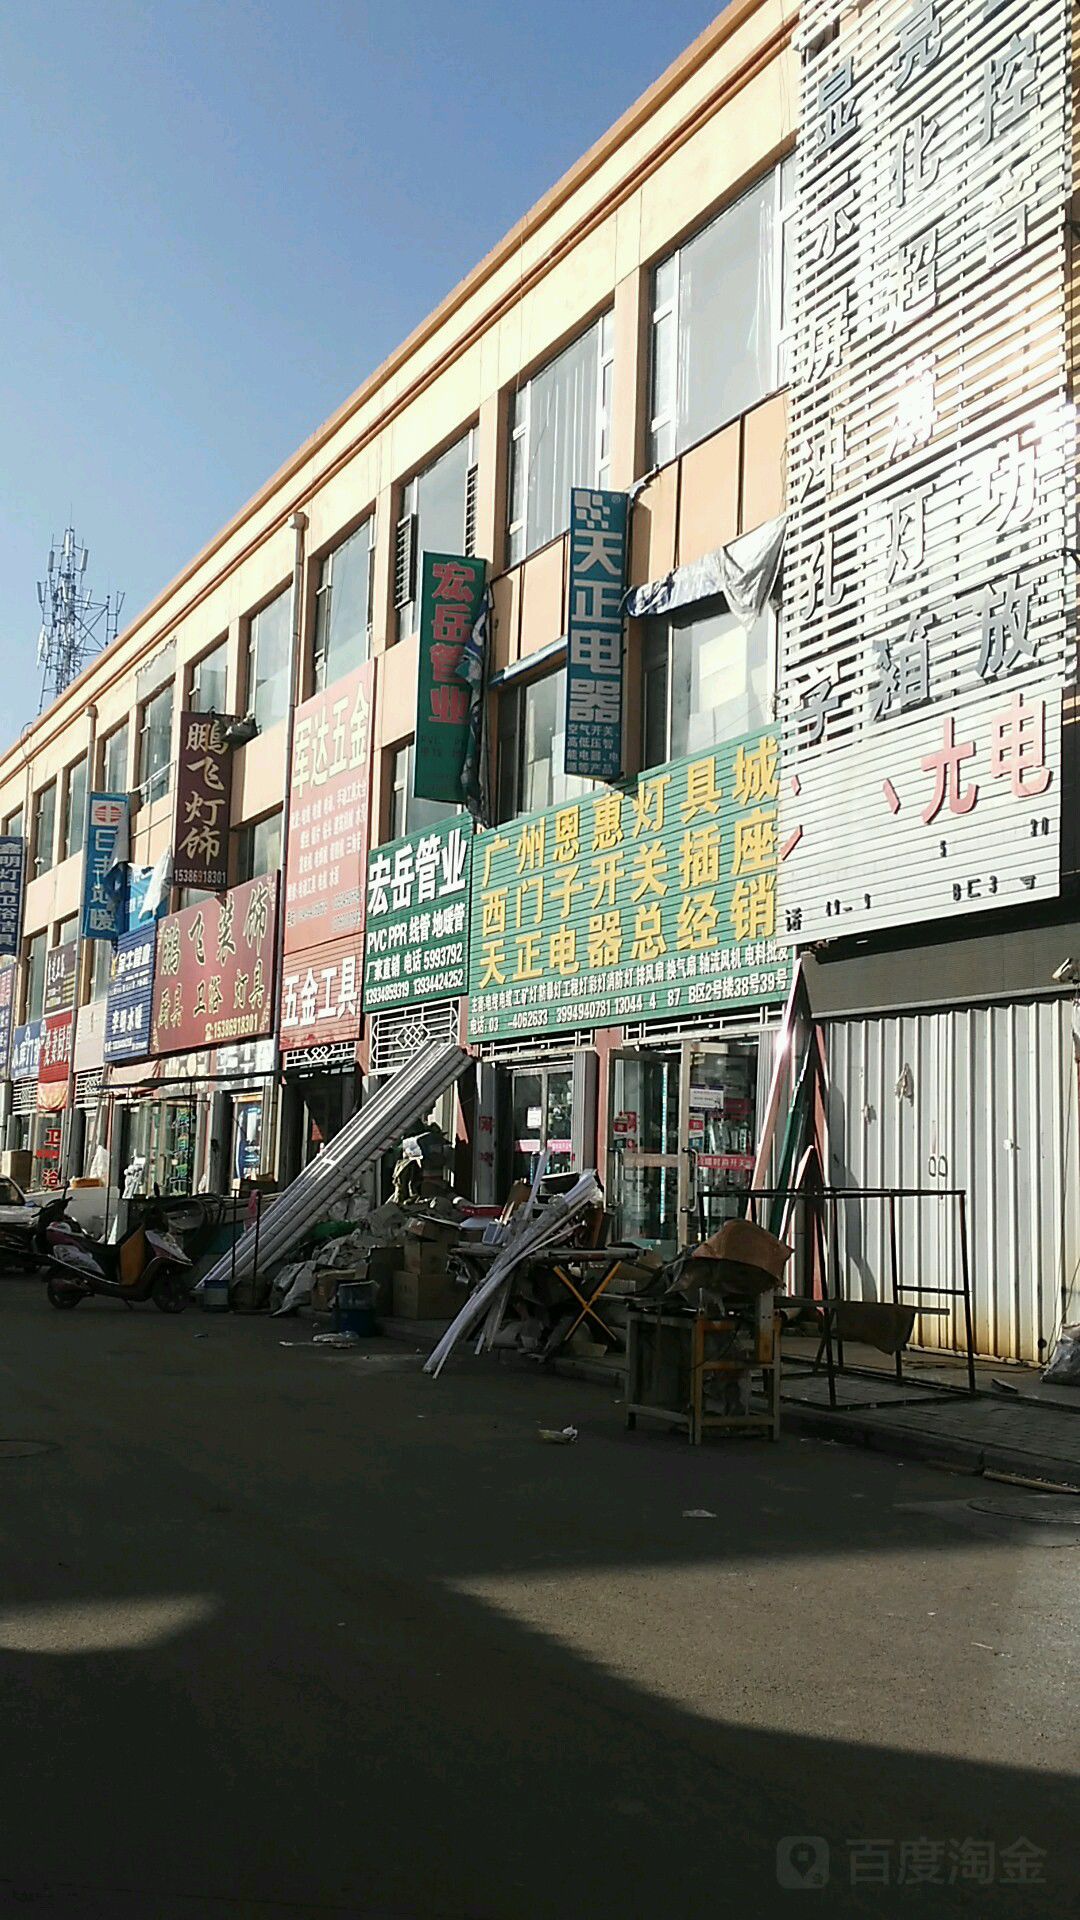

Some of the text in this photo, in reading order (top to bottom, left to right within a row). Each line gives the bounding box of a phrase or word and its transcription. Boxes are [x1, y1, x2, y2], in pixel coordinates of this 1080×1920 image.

[428, 560, 475, 725] 宏岳管业
[569, 528, 623, 723] 天正电器
[178, 719, 229, 866] 鹏飞灯饰
[482, 736, 780, 888] 广州恩惠灯具城
[174, 869, 226, 884] 15386918301
[367, 827, 467, 917] 宏岳管业
[480, 808, 778, 937] 西门子开关插座
[365, 952, 401, 983] 厂家直销
[404, 947, 422, 975] 电话
[367, 930, 388, 955] PVC
[388, 921, 408, 949] PPR
[432, 901, 466, 937] 地暖管
[478, 873, 776, 990] 天正电器总经销
[233, 958, 265, 1010] 灯具
[282, 955, 358, 1028] 五金工具
